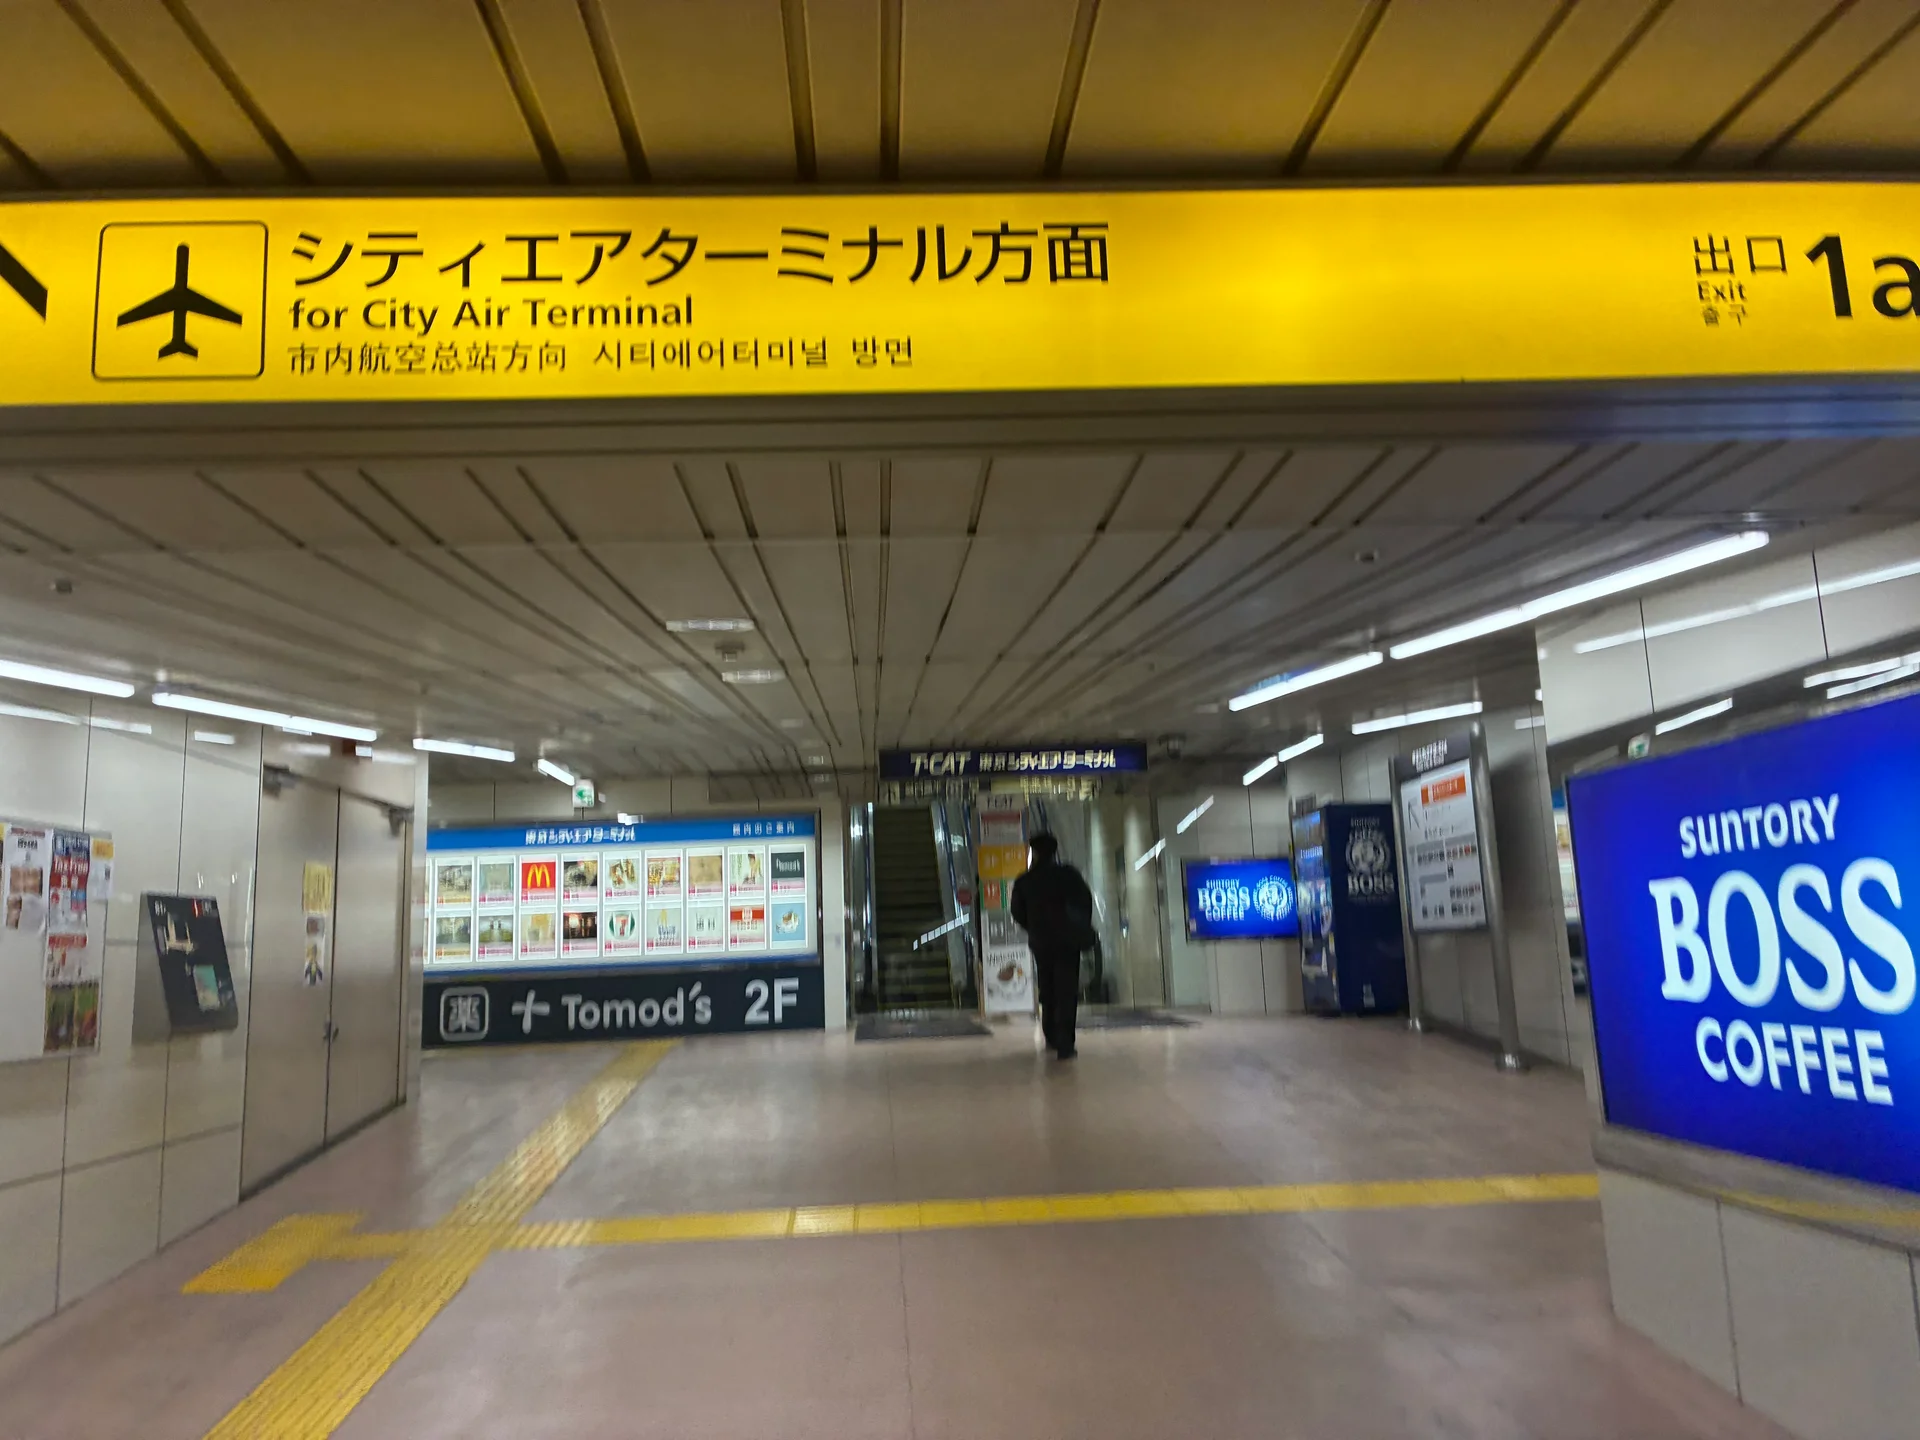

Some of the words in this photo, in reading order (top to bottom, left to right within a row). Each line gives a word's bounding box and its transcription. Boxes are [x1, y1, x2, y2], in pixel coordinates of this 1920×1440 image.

[291, 222, 1109, 285] シティエアターミナル方面
[1693, 233, 1787, 275] 出口
[1697, 280, 1747, 302] Exit
[1804, 232, 1920, 321] 1a
[289, 298, 348, 331] for
[362, 298, 438, 336] City
[453, 297, 510, 328] Air
[523, 295, 693, 327] Terminal
[288, 341, 567, 376] 市内航空总站方向
[592, 336, 829, 371] 시티에어터미널
[851, 335, 914, 367] 방면
[1648, 857, 1917, 1015] BOSS
[744, 978, 799, 1025] 2F
[1696, 1016, 1894, 1106] COFFEE
